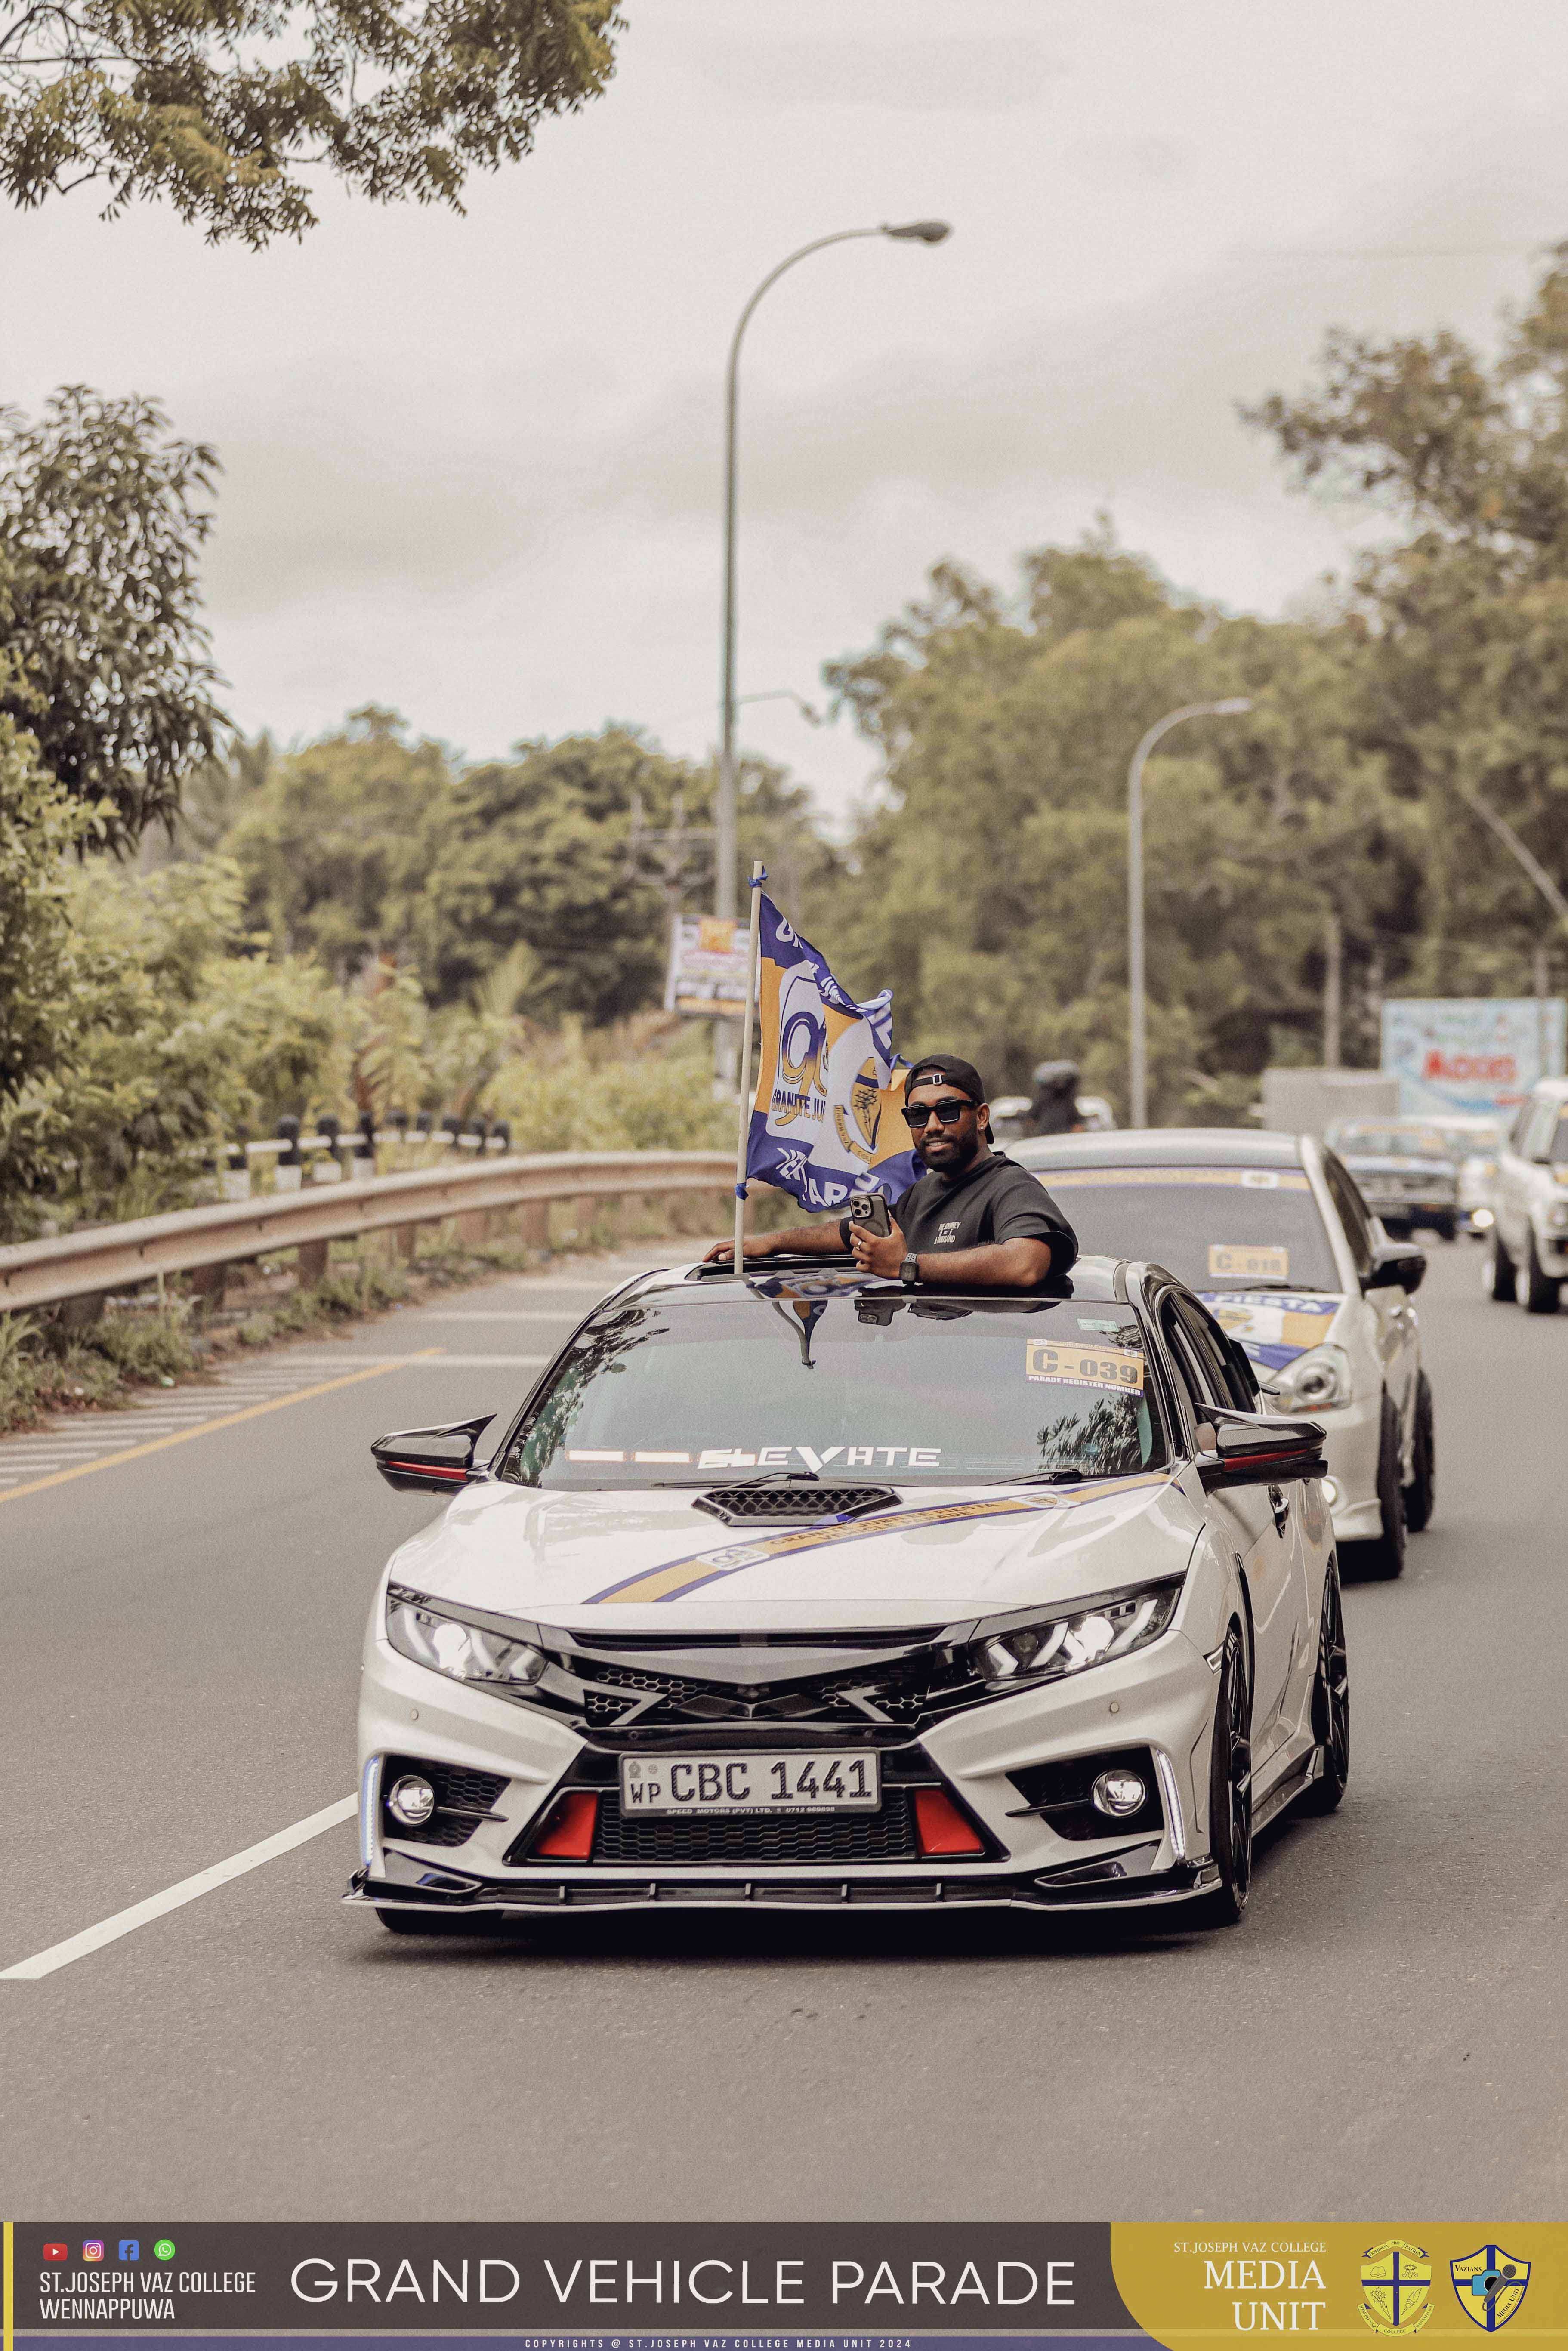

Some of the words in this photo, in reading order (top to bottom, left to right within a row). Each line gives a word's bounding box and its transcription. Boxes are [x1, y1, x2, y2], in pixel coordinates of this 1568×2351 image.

[1028, 1375, 1062, 1384] PARADE
[1062, 1377, 1104, 1389] REGISTER
[1105, 1383, 1142, 1396] NUMBER
[935, 1502, 1000, 1515] FIESTA
[900, 1510, 974, 1527] PARADE
[630, 1783, 661, 1803] WP
[671, 1762, 750, 1802] CBC
[771, 1759, 872, 1800] 1441
